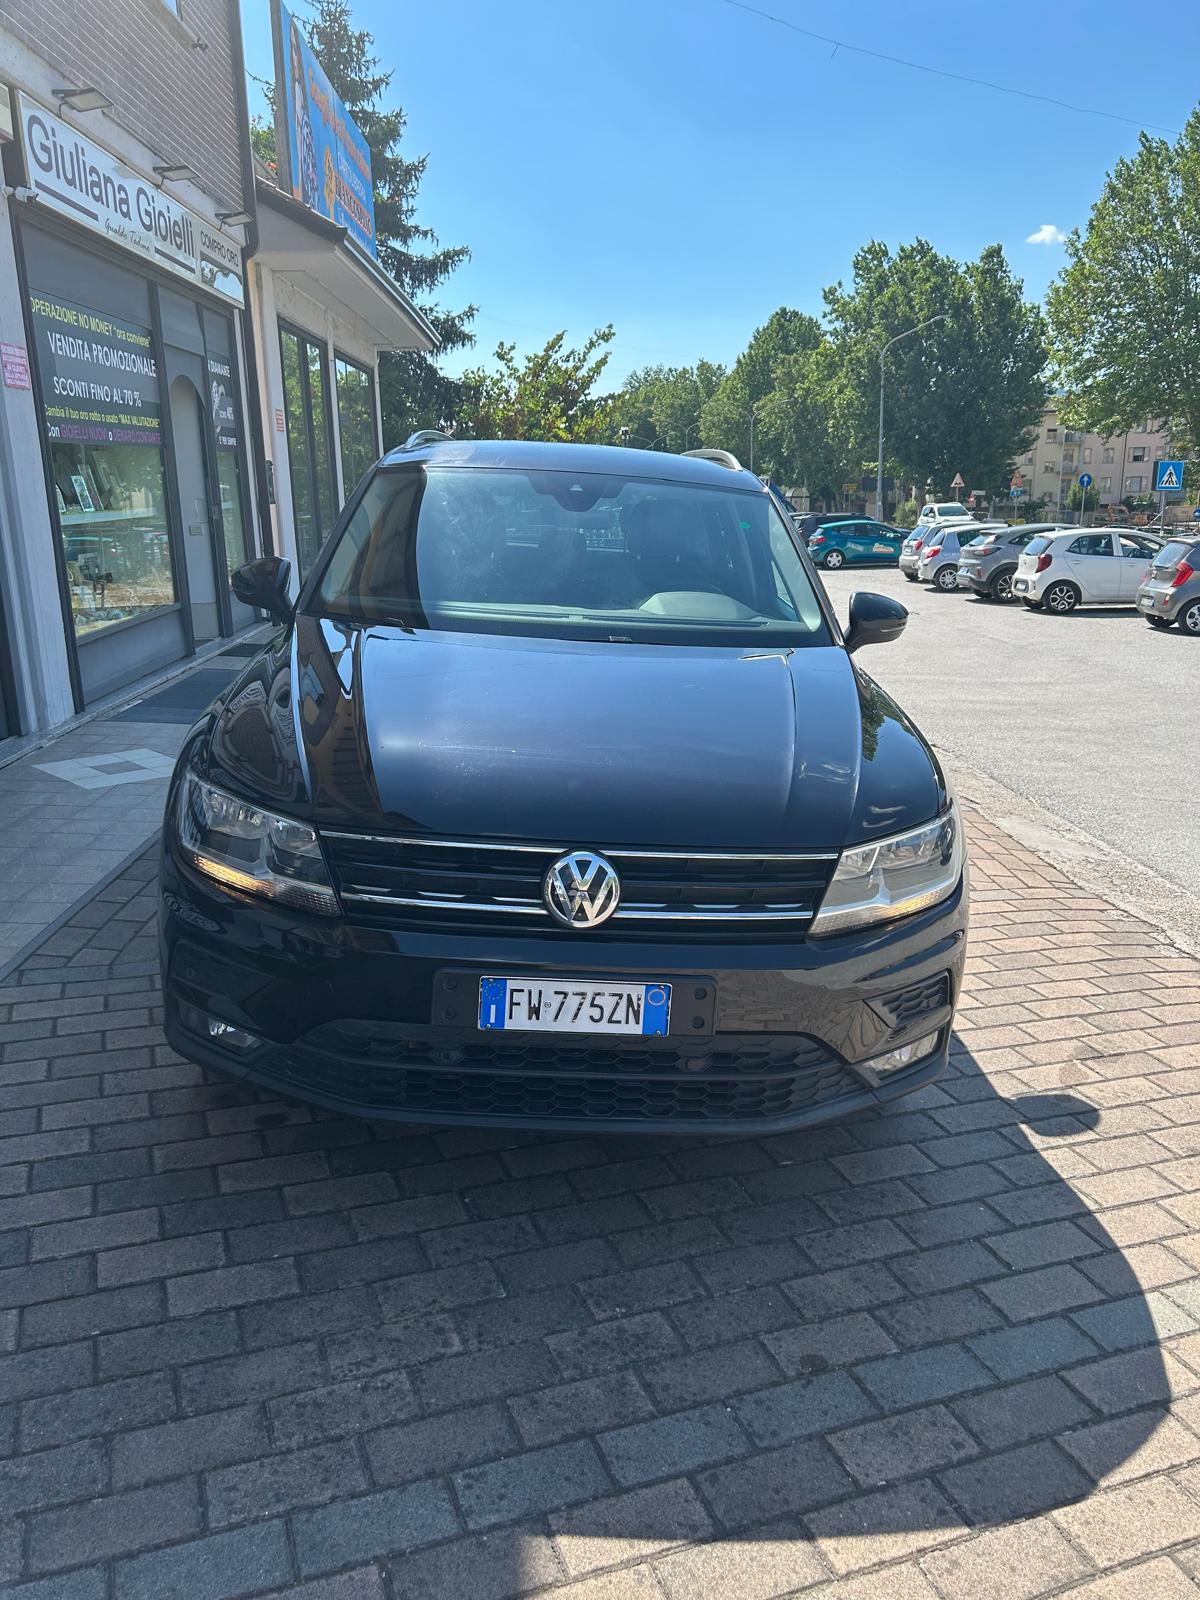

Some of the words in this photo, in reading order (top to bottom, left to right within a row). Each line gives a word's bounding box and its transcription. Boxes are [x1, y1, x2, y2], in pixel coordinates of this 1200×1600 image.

[27, 114, 132, 221] Giuliana
[136, 187, 195, 258] Gioielli
[200, 231, 226, 260] COMPRO
[226, 248, 239, 267] ORO
[30, 297, 78, 326] OPERAZIONE
[79, 313, 89, 329] NO
[89, 316, 113, 336] MONEY
[47, 331, 92, 362] VENDITA
[92, 343, 157, 378] PROMOZIONALE
[53, 376, 89, 398] SCONTI
[90, 383, 111, 402] FINO
[113, 388, 123, 404] AL
[123, 389, 133, 406] 70
[133, 391, 142, 407] %
[79, 411, 88, 420] oro
[544, 851, 620, 927] VW
[508, 988, 543, 1021] FW
[553, 990, 642, 1025] 775ZN
